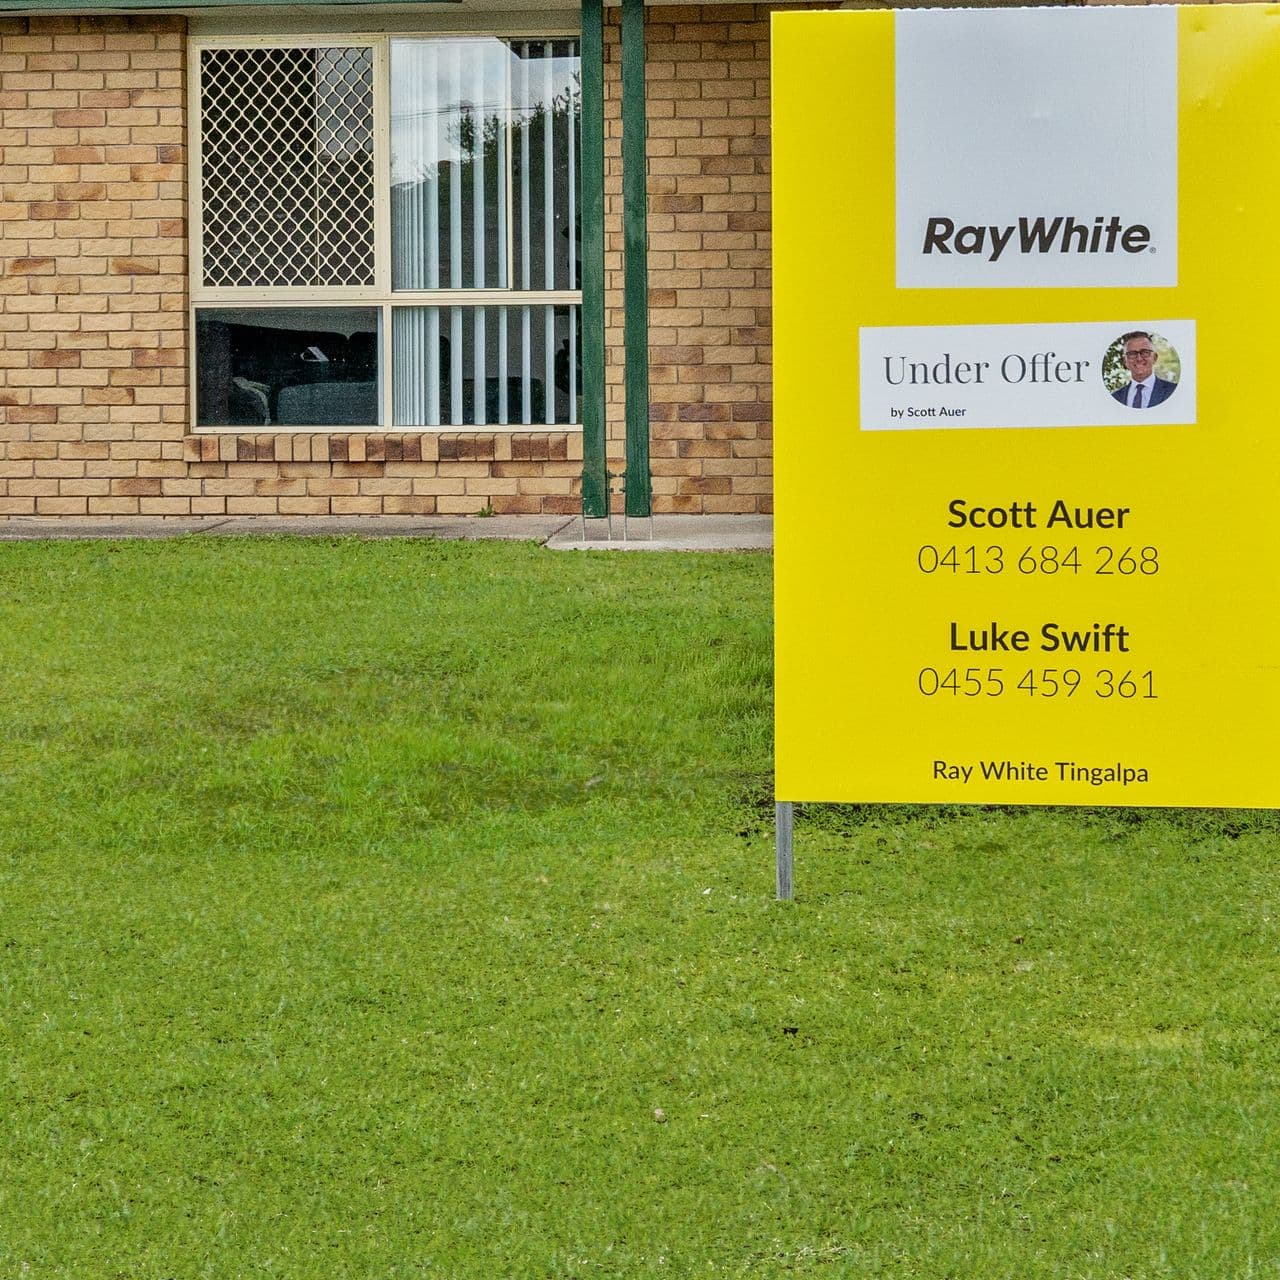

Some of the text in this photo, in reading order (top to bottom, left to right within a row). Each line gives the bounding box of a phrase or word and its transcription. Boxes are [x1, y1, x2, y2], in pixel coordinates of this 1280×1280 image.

[883, 351, 1090, 386] Under Offer
[890, 406, 967, 418] by Scott Auer
[948, 499, 1131, 529] Scott Auer
[918, 545, 1160, 576] 0413 684 268
[950, 621, 1130, 653] Luke Swift
[918, 667, 1159, 699] 0455 459 361
[933, 760, 1149, 786] Ray White Tingalpa
